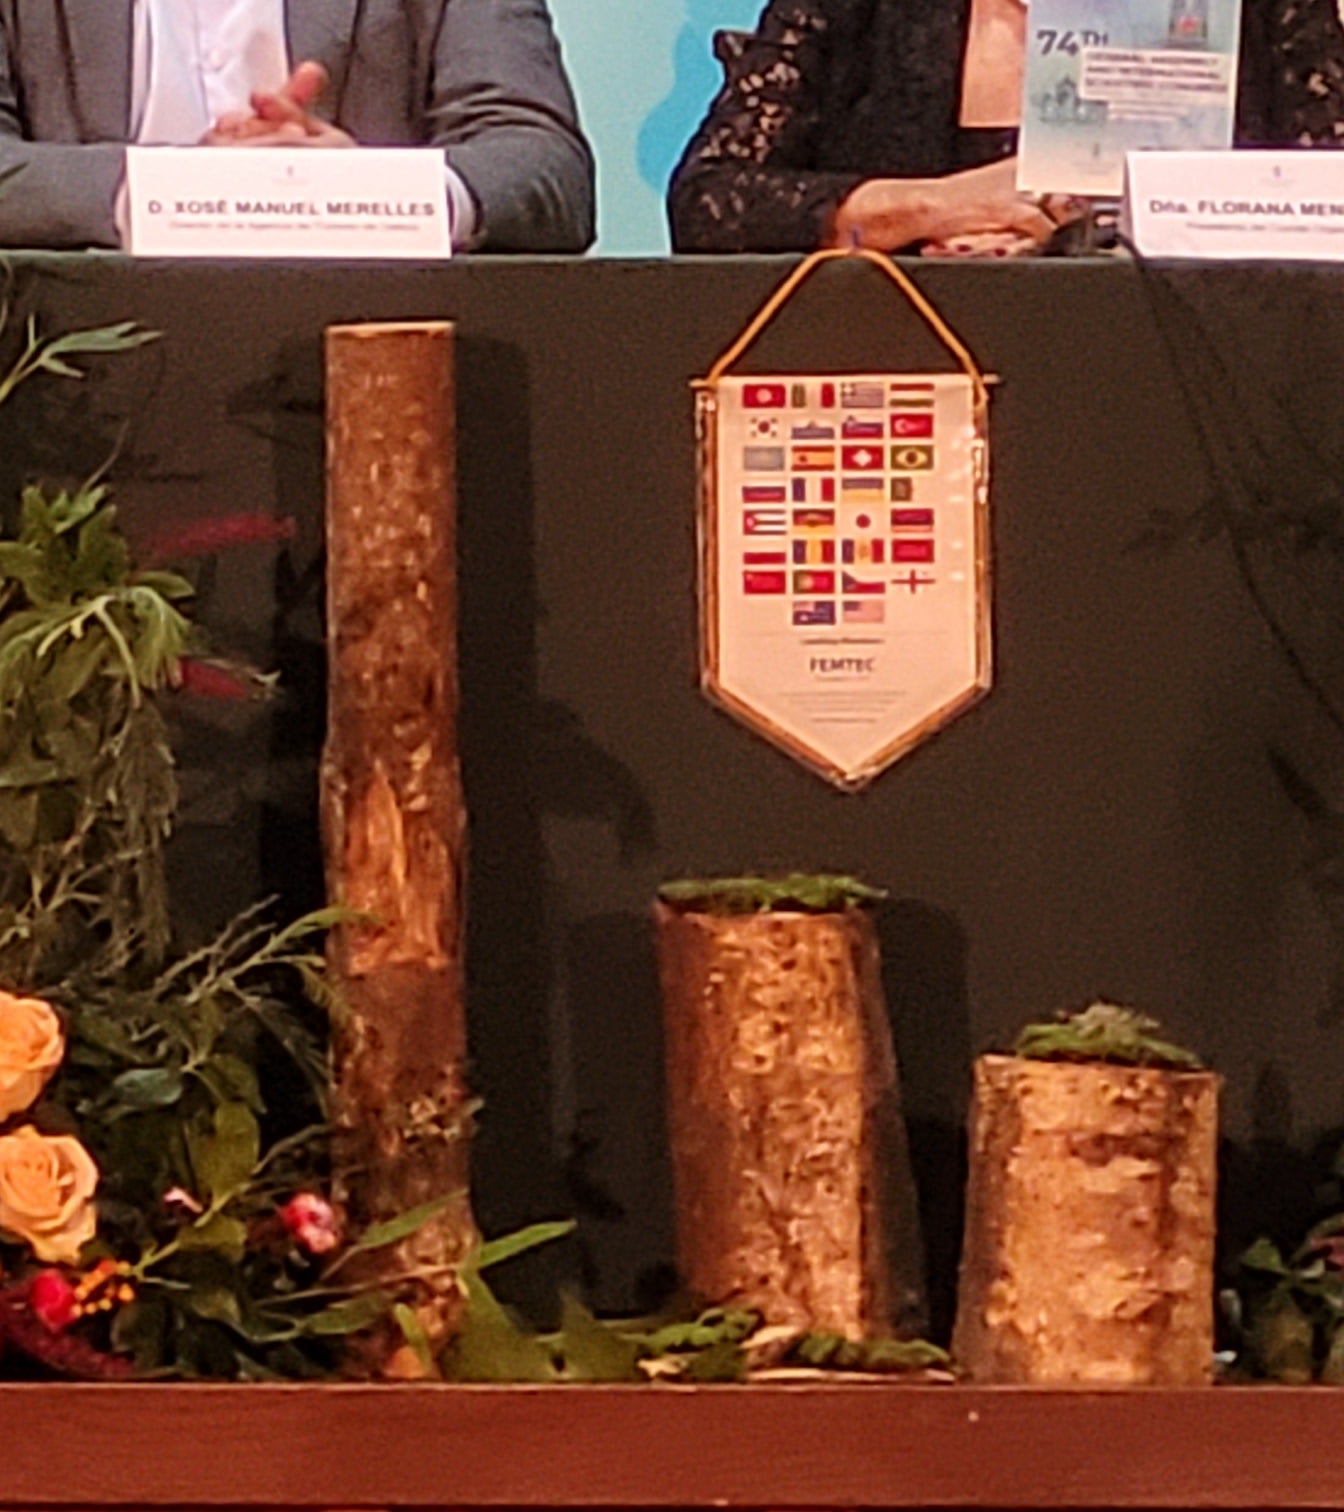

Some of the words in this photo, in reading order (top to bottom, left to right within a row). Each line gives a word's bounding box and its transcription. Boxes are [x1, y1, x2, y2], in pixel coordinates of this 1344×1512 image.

[174, 197, 227, 215] XOSÉ
[236, 201, 320, 216] MANUEL
[325, 201, 436, 217] MERELLES
[1198, 200, 1295, 216] FLORANA
